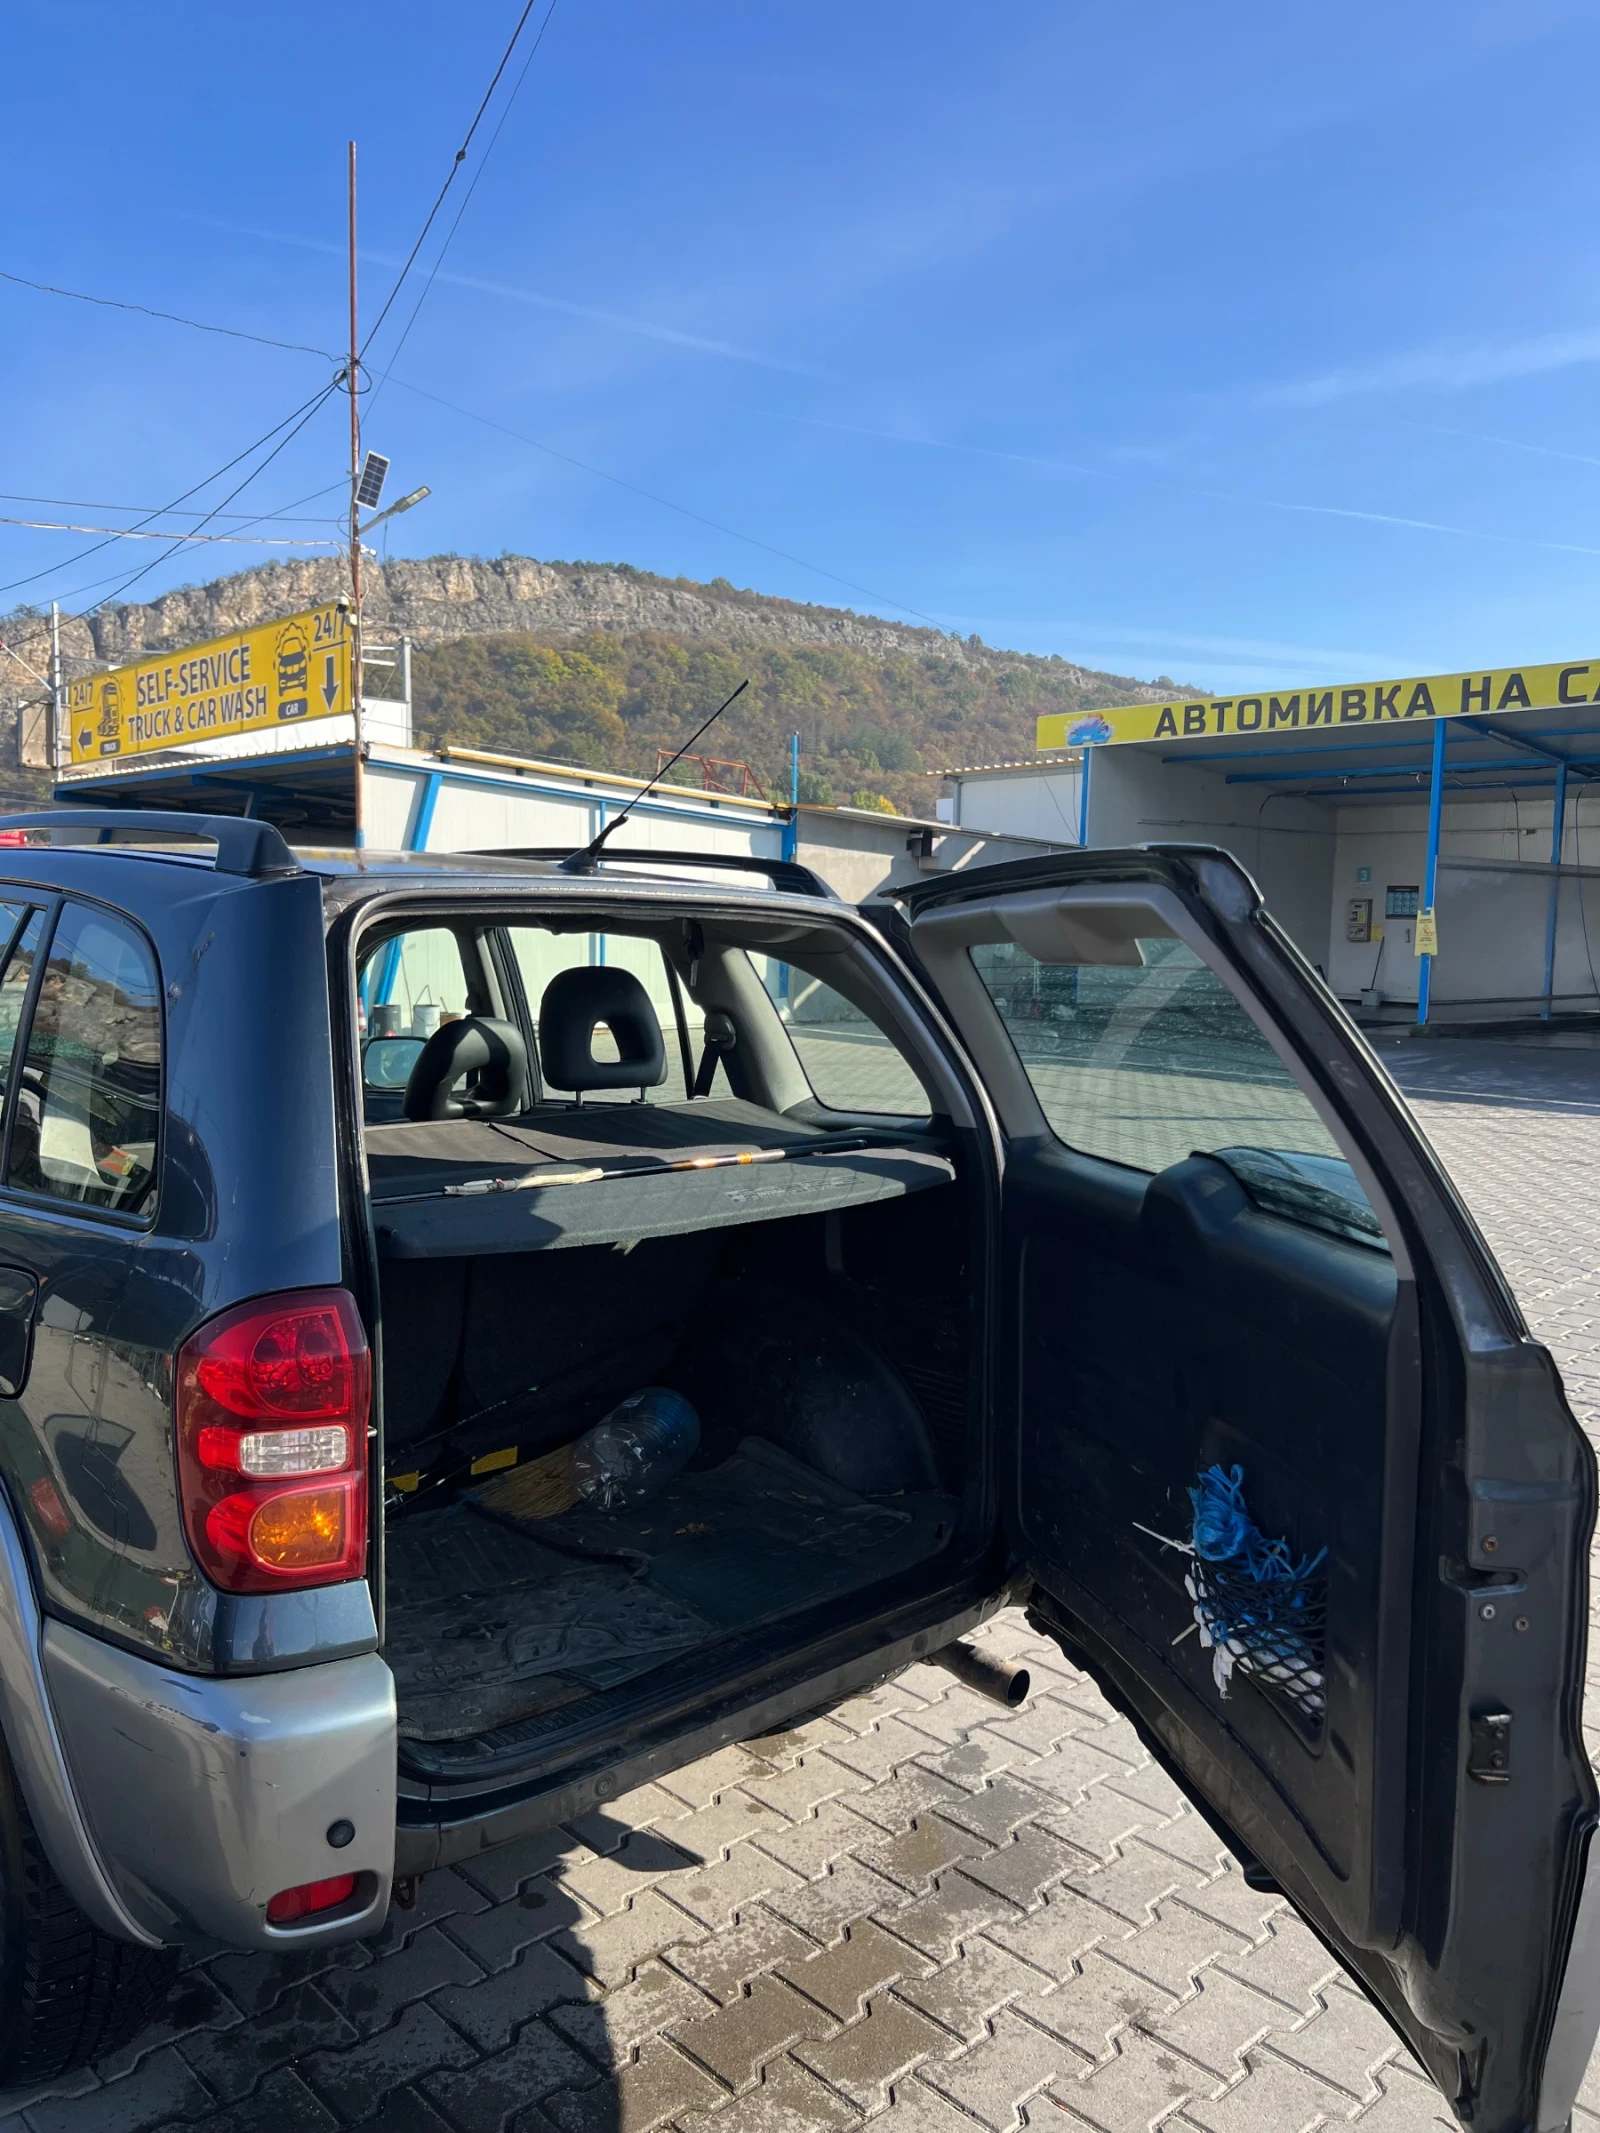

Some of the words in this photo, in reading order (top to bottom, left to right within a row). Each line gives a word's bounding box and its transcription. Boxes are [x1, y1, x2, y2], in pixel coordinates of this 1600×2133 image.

[73, 681, 94, 707] 24/7
[136, 646, 251, 708] SELF-SERVICE
[128, 708, 171, 742] TRUCK
[174, 706, 185, 734] &
[187, 697, 217, 730] CAR
[220, 685, 267, 724] WASH
[285, 703, 299, 716] CAR
[1153, 682, 1436, 738] АВТОМИВКА
[1460, 672, 1532, 713] НА
[1360, 869, 1368, 881] 3
